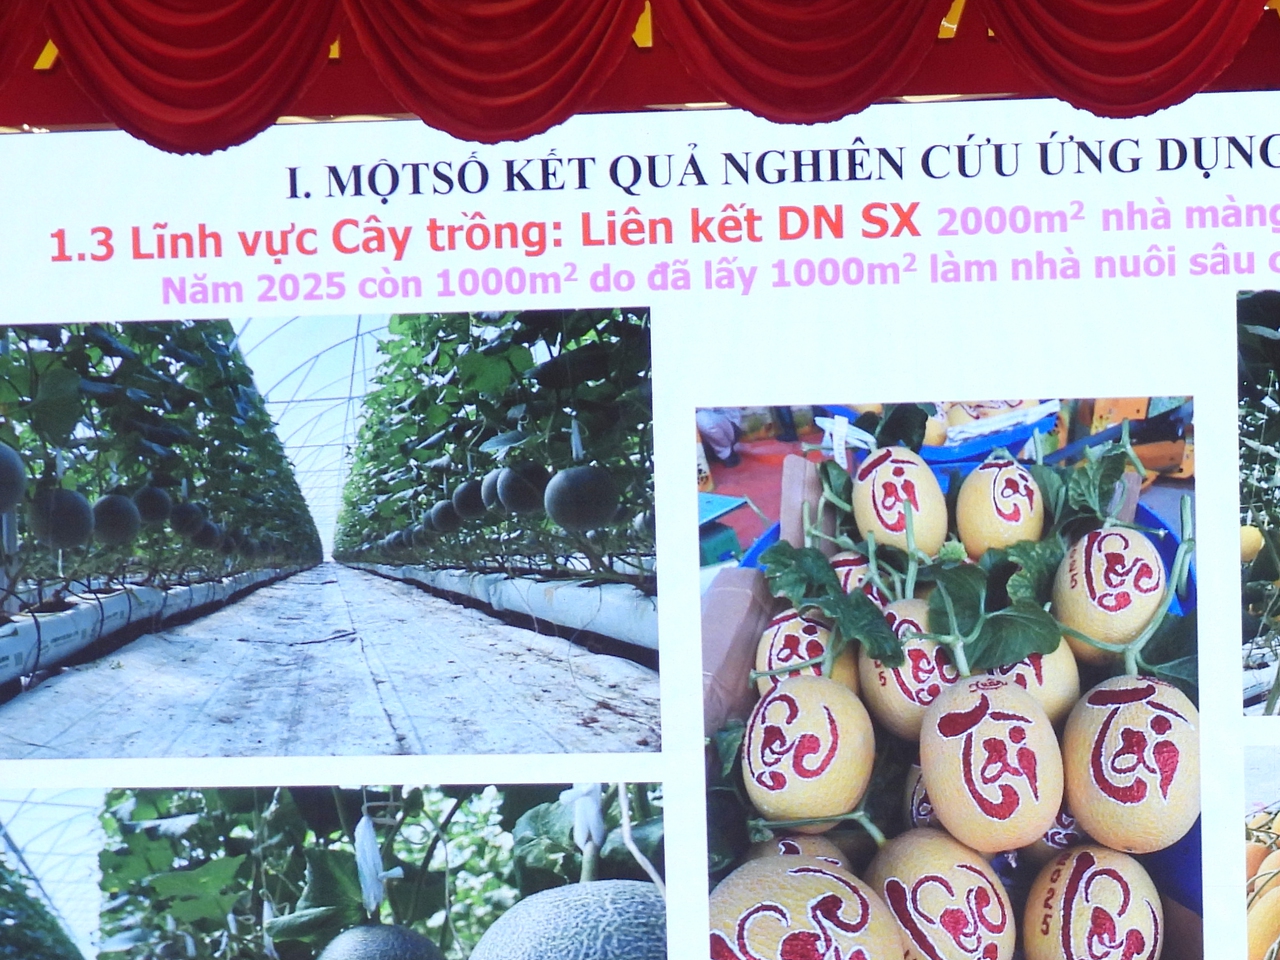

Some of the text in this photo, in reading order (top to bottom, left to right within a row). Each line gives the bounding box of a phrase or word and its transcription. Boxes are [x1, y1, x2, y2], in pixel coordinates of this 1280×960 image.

[286, 166, 311, 199] I.
[503, 148, 596, 193] KẾT
[609, 143, 708, 196] QUẢ
[721, 136, 907, 186] NGHIÊN
[921, 133, 1023, 180] CỨU
[1036, 131, 1143, 176] ỨNG
[52, 228, 114, 261] 1.3
[132, 223, 222, 259] Lĩnh
[239, 230, 316, 265] vực
[333, 214, 411, 260] Cây
[428, 210, 562, 257] trồng:
[581, 207, 673, 247] Liên
[690, 204, 763, 243] kết
[779, 205, 844, 240] DN
[861, 202, 921, 238] SX
[1102, 197, 1171, 231] nhà
[161, 272, 243, 306] Năm
[257, 271, 347, 303] 2025
[358, 266, 422, 299] còn
[589, 263, 636, 293] do
[647, 258, 691, 291] đã
[704, 255, 757, 296] lấy
[930, 250, 997, 283] làm
[1011, 247, 1081, 281] nhà
[1094, 244, 1176, 279] nuôi
[1189, 242, 1255, 276] sâu
